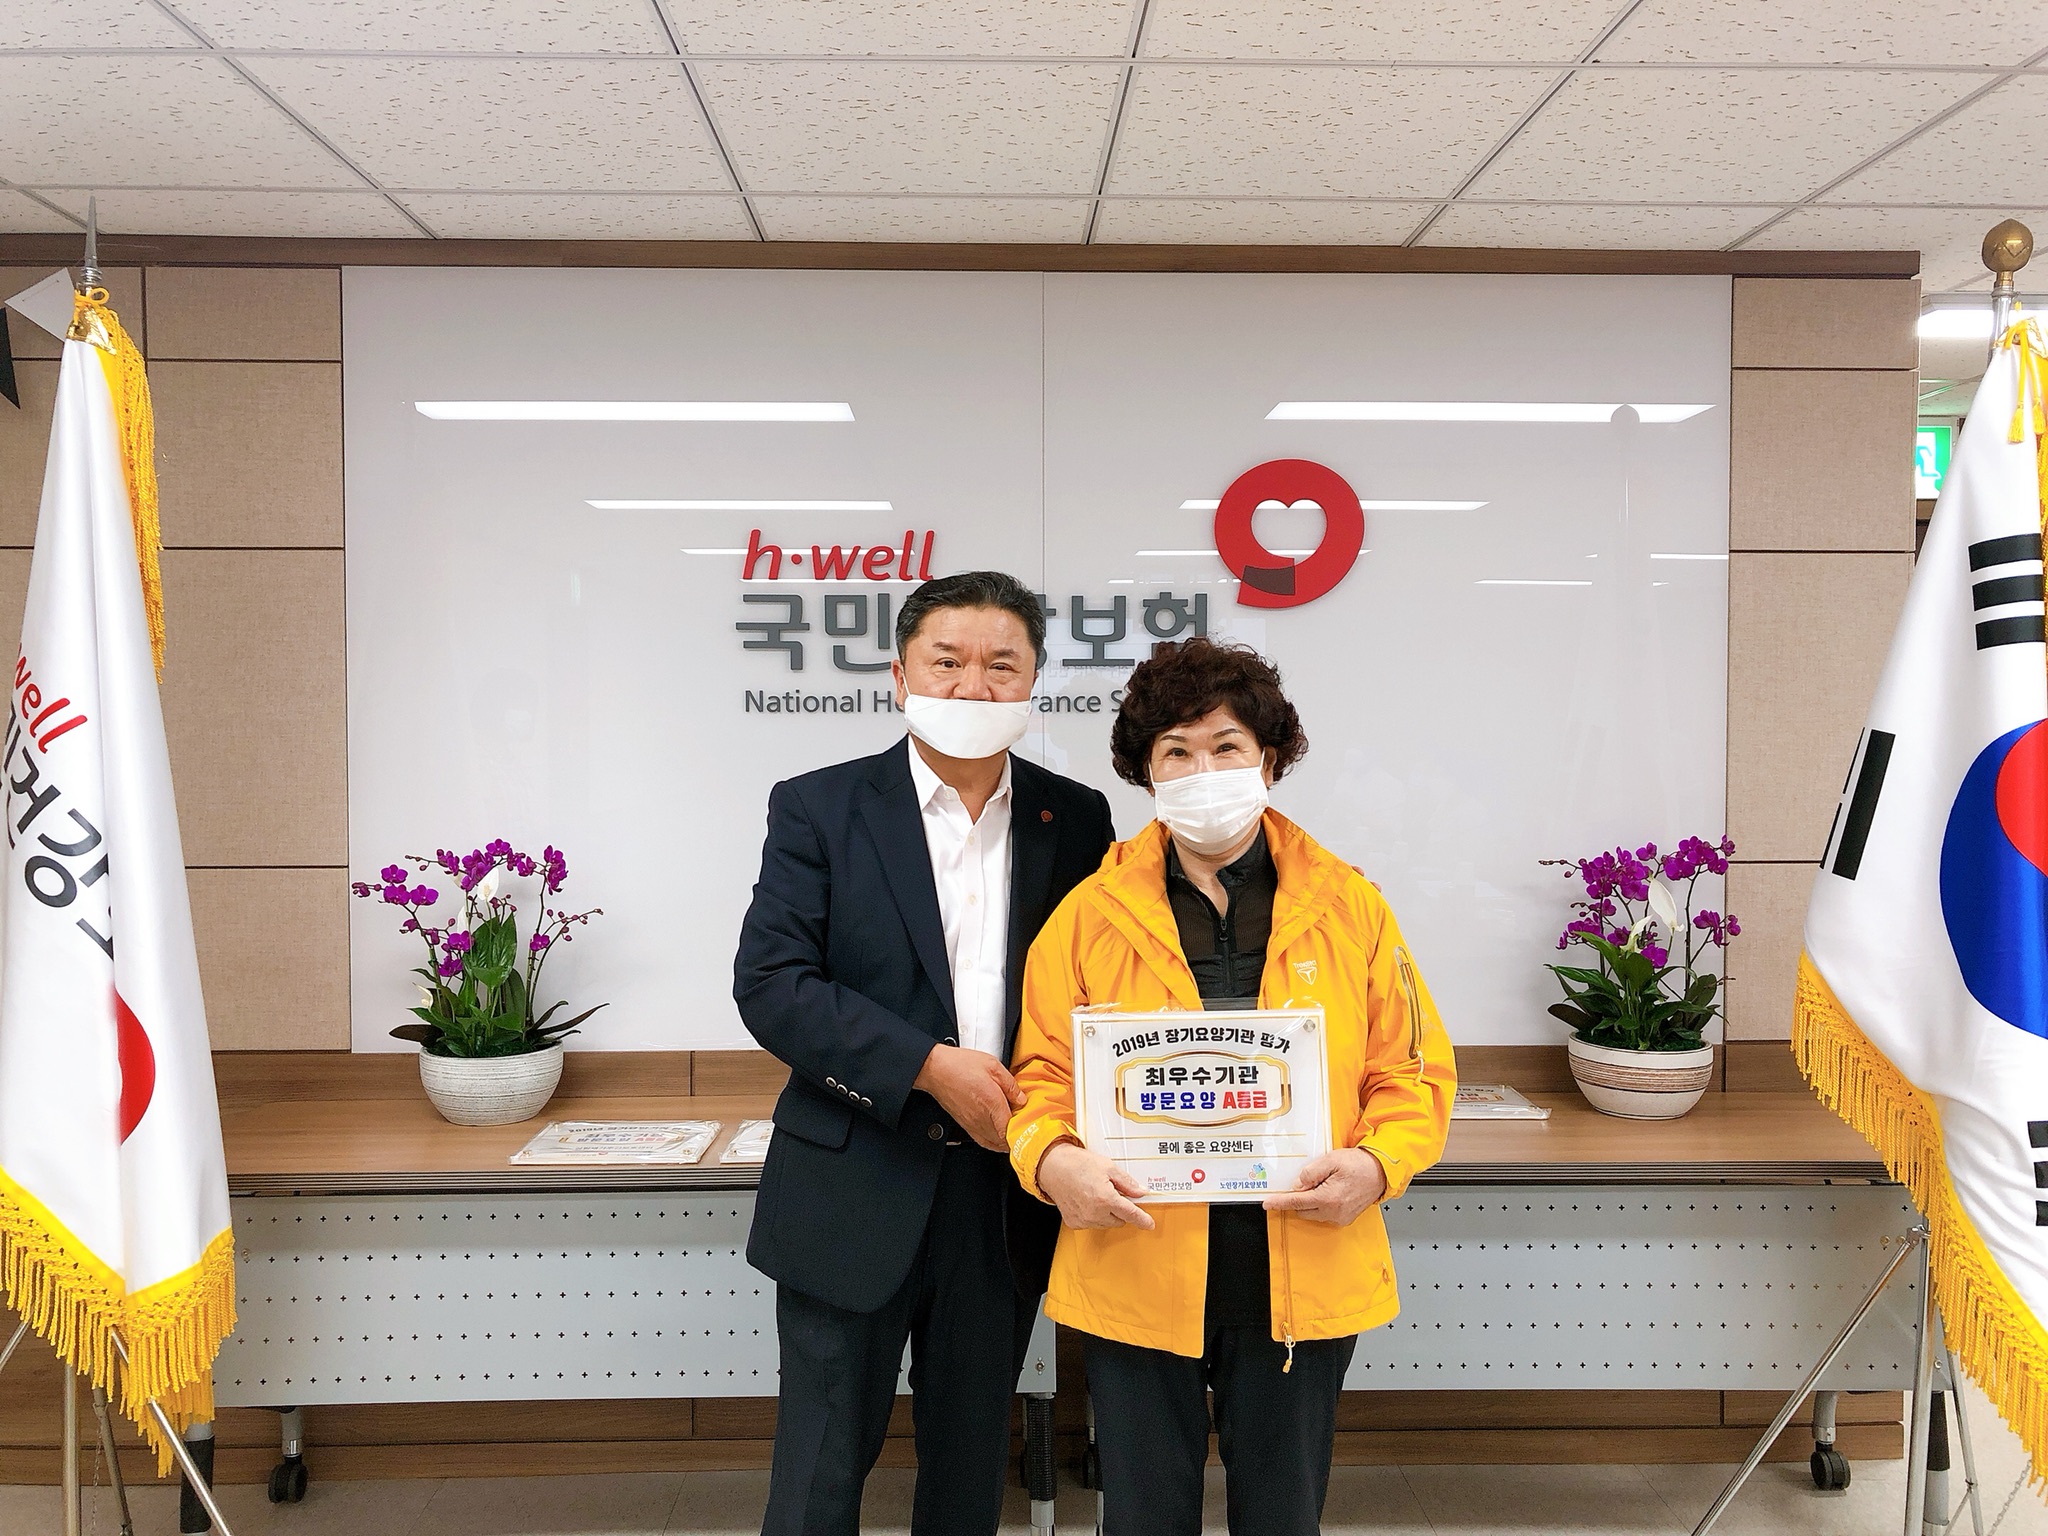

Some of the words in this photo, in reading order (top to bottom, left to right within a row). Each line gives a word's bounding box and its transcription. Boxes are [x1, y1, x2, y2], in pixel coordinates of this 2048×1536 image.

[736, 591, 1208, 672] 국민보험
[745, 689, 862, 713] National
[1112, 1030, 1161, 1057] 2019년
[1164, 1026, 1256, 1044] 장기요양기관
[1259, 1031, 1291, 1054] 평가
[1145, 1065, 1260, 1087] 최우수기관
[1140, 1091, 1216, 1111] 방문요양
[1222, 1090, 1268, 1109] A등급
[1158, 1141, 1180, 1155] 몸에
[1183, 1141, 1206, 1154] 좋은
[1209, 1140, 1254, 1153] 요양센타
